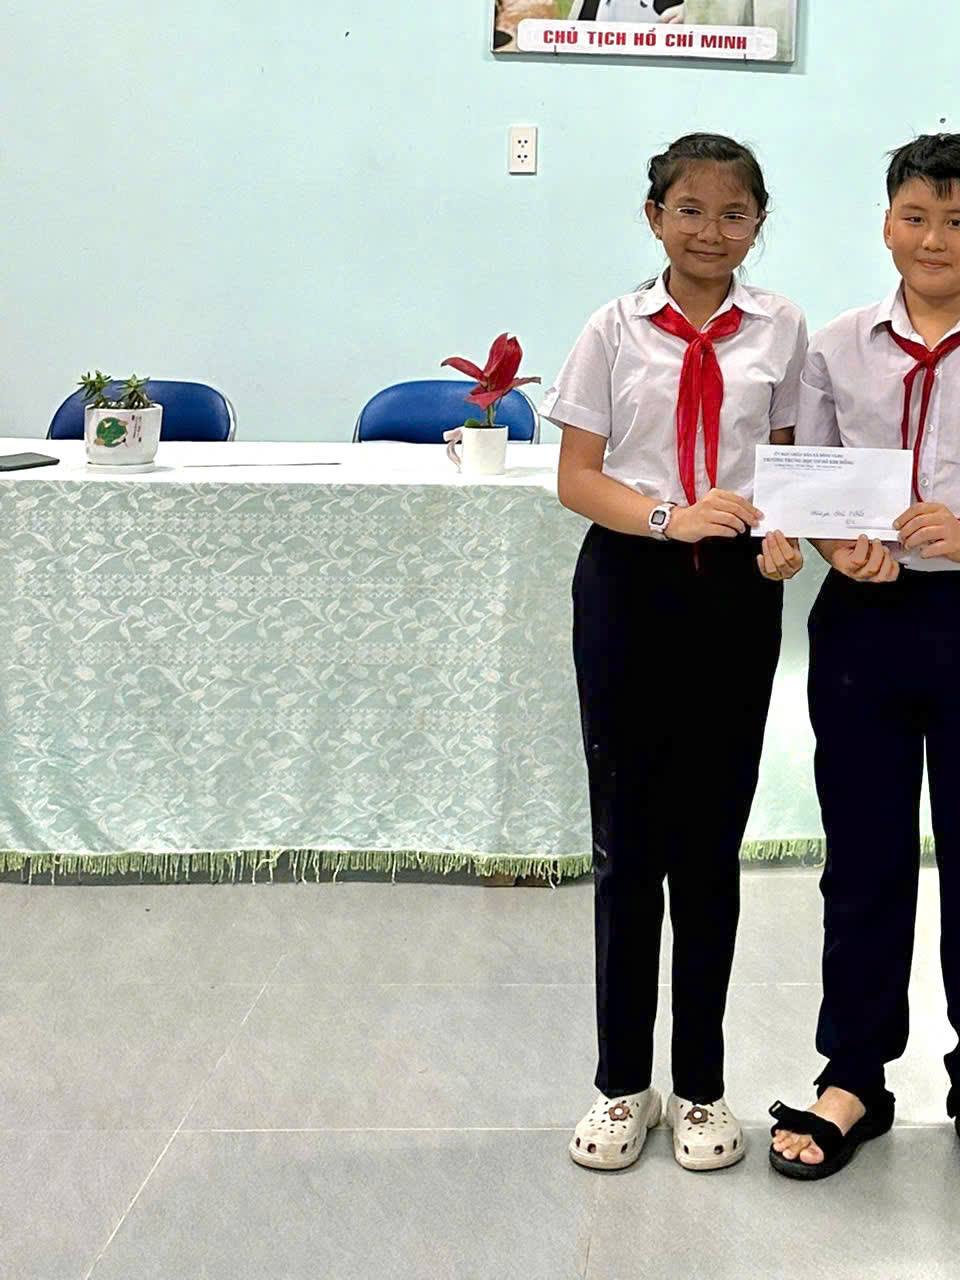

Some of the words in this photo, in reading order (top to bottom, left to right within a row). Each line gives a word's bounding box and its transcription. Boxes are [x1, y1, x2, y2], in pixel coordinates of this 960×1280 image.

[543, 26, 578, 45] CHỦ
[587, 31, 626, 48] TỊCH
[665, 30, 694, 48] CHÍ
[700, 34, 747, 50] MINH
